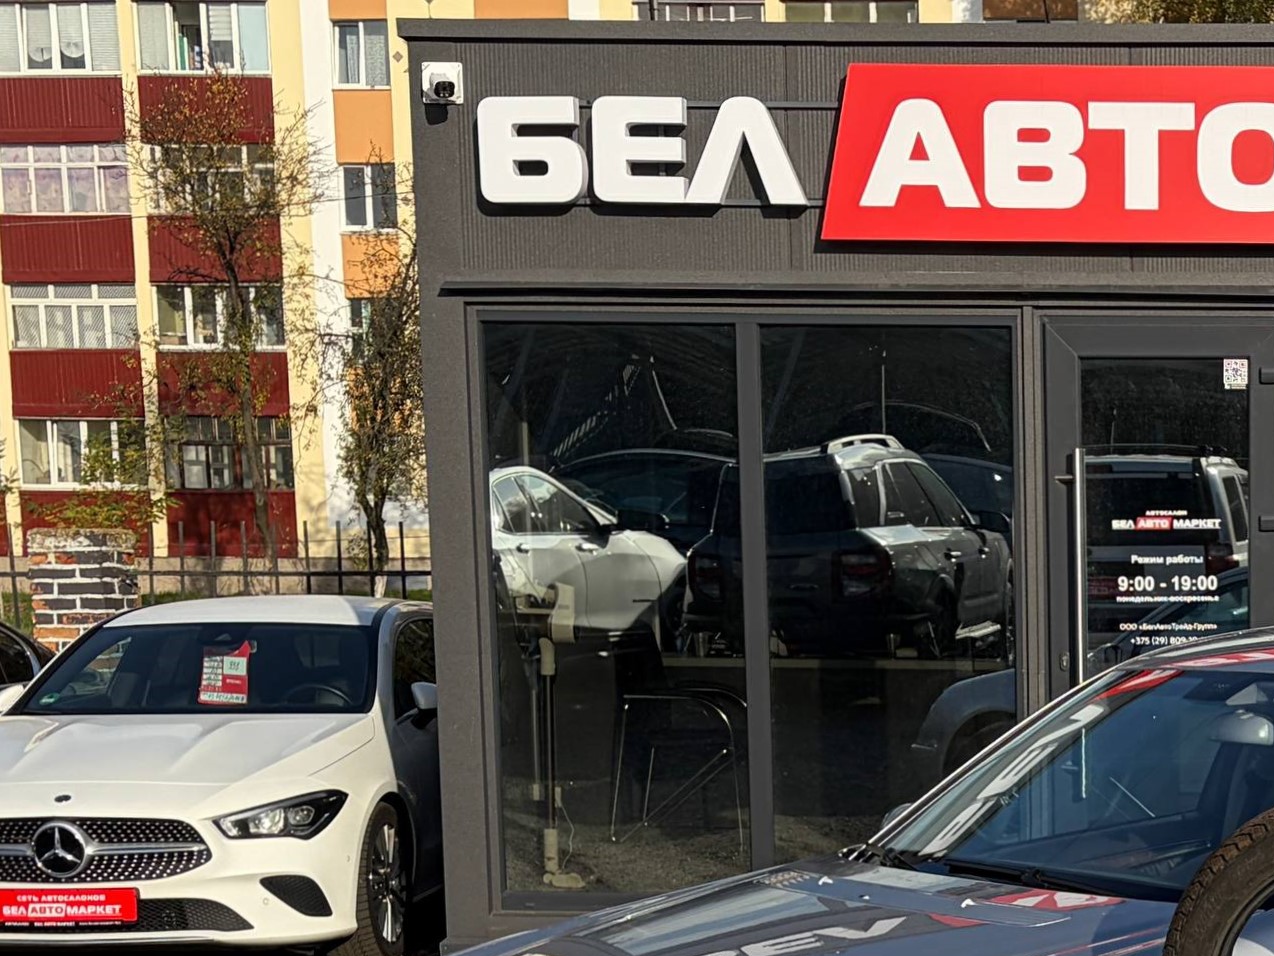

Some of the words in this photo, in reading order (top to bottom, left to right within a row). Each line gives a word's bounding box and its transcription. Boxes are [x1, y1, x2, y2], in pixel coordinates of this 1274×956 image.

[476, 95, 809, 206] БЕЛ
[1112, 519, 1136, 530] БЕЛ
[1137, 519, 1169, 529] АВТО
[1173, 519, 1221, 530] МАРКЕТ
[1131, 555, 1164, 564] Режим
[1166, 554, 1204, 566] работы
[1117, 576, 1155, 592] 9:00
[1171, 575, 1218, 592] 19:00
[1120, 623, 1138, 631] ООО
[1130, 636, 1150, 645] +375
[1151, 636, 1168, 646] (29)
[41, 894, 106, 902] АВТОСАЛОНОВ
[3, 906, 27, 916] БЕЛ
[29, 906, 65, 915] АВТО
[66, 905, 121, 915] МАРКЕТ
